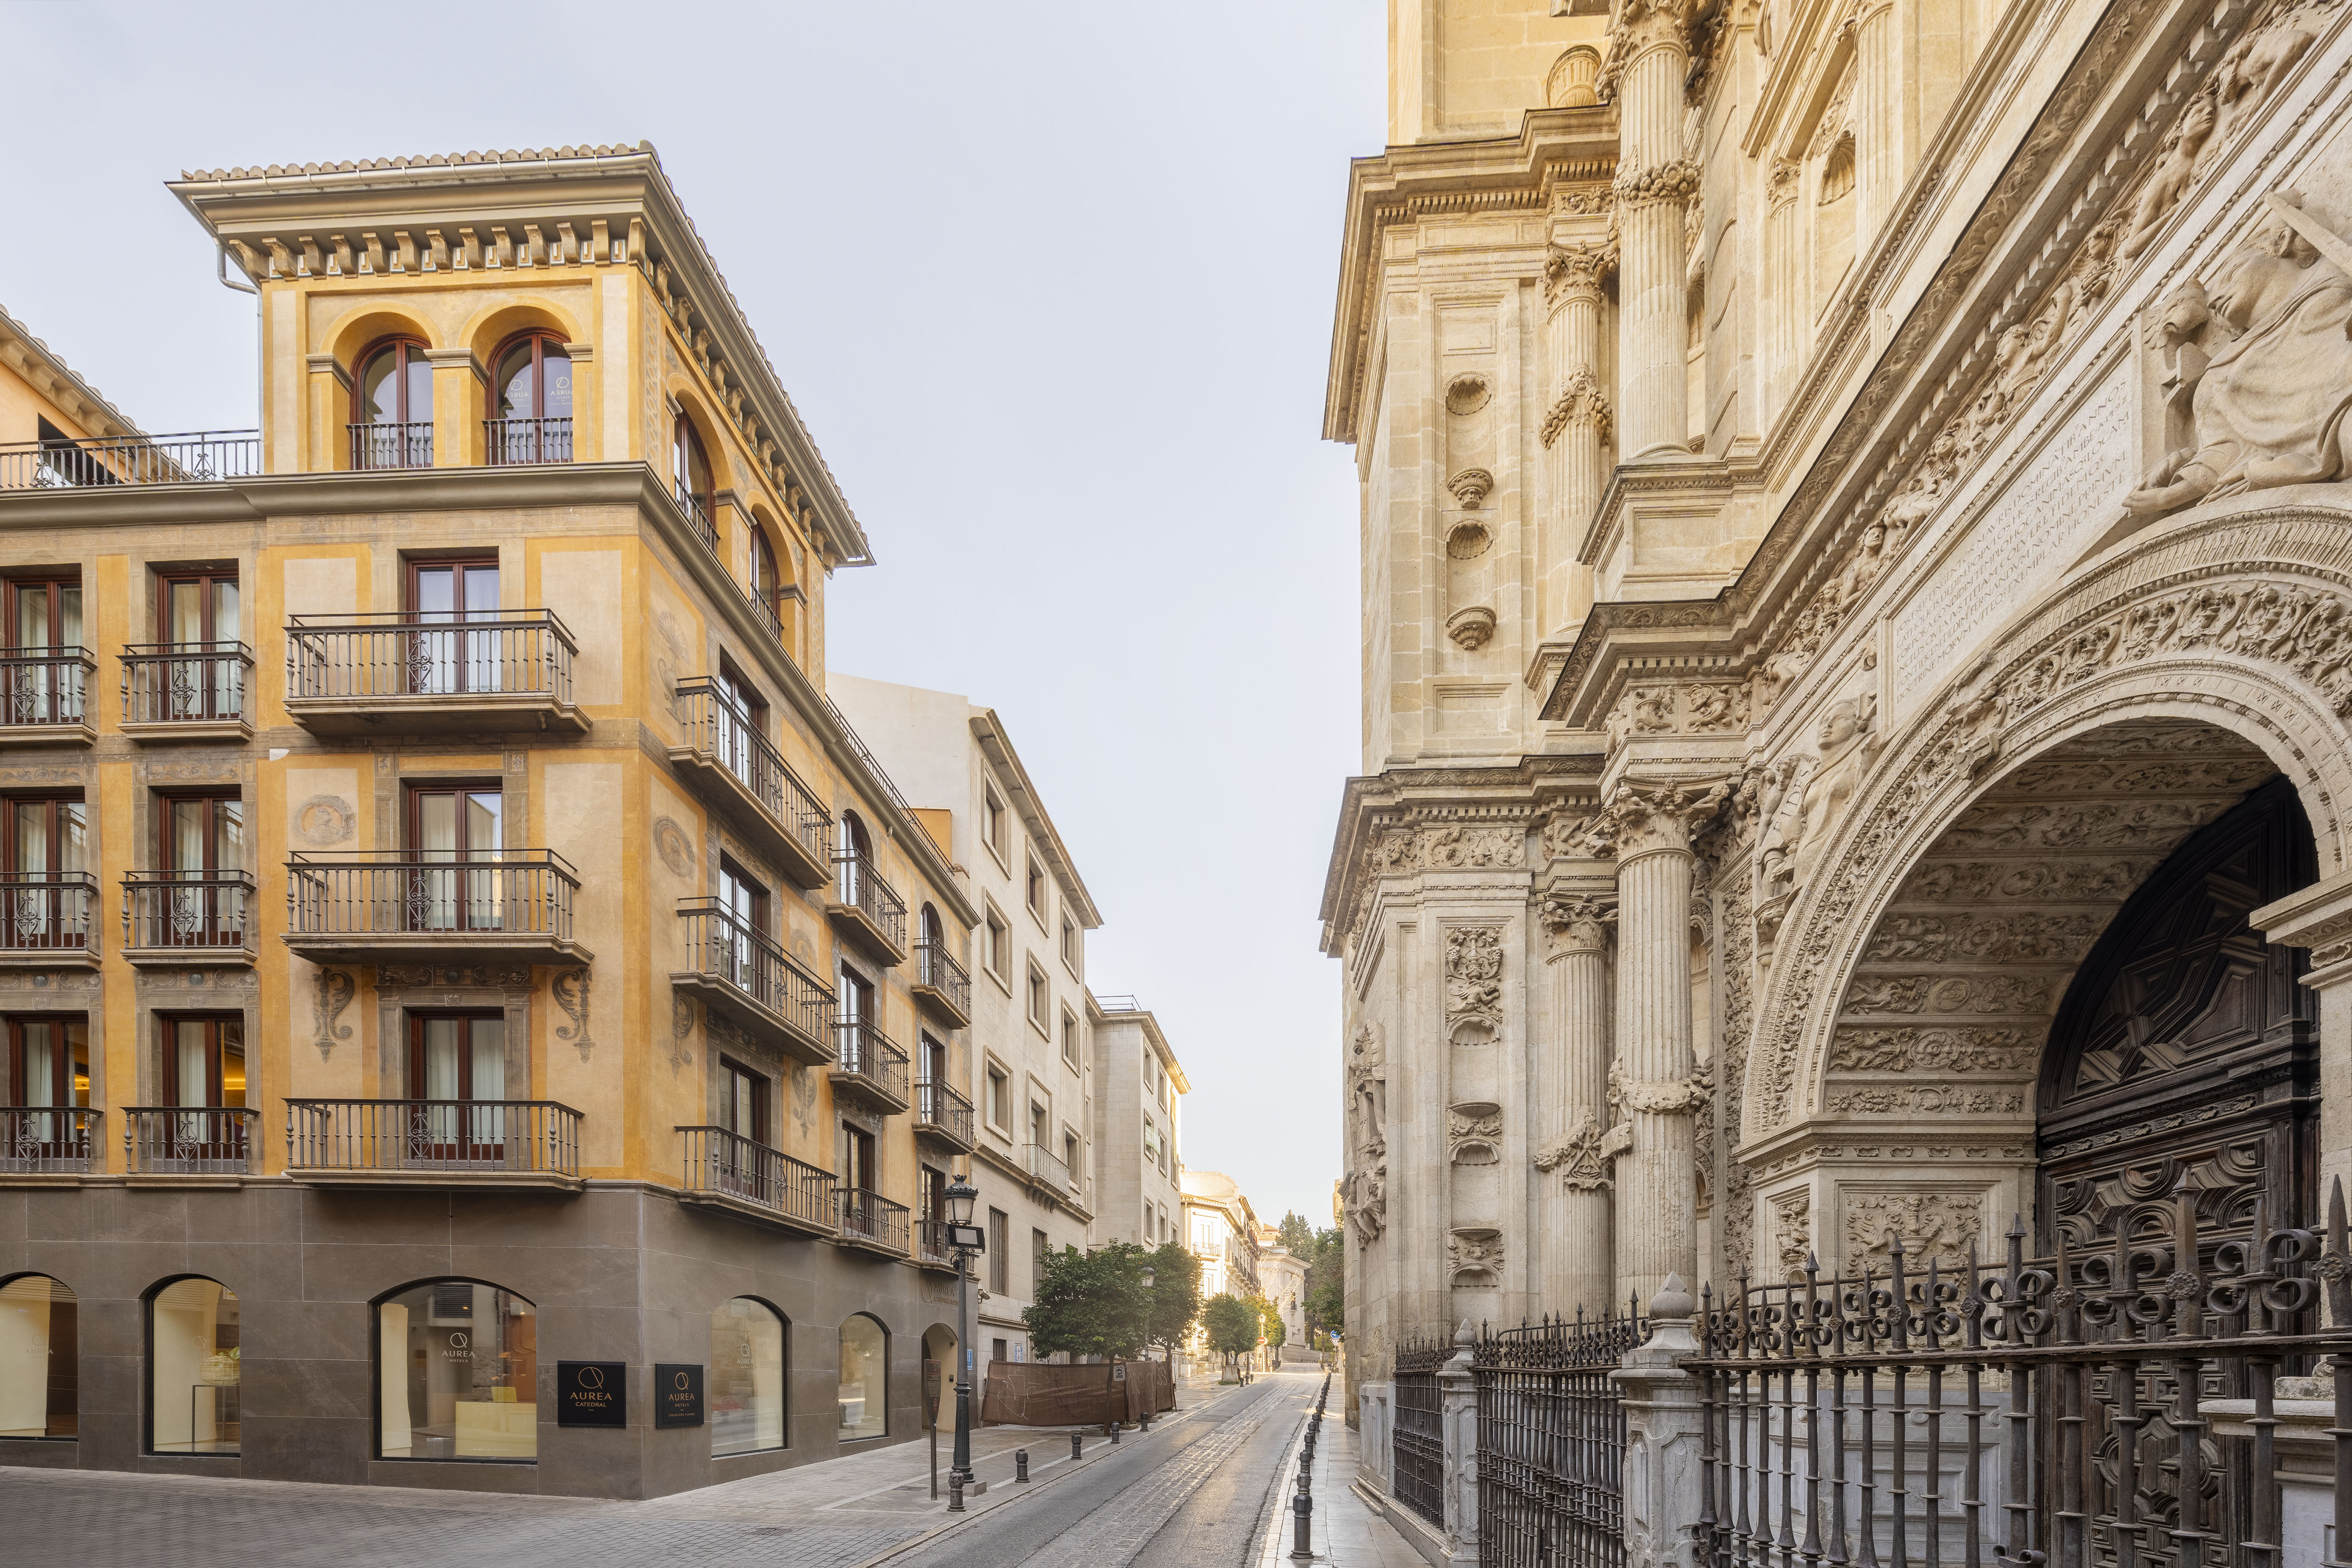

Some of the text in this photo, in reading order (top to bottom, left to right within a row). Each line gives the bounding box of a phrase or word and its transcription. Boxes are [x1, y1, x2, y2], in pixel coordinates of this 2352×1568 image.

[1970, 548, 2029, 616] FERNANDVM
[2078, 449, 2125, 507] PRIMVM
[2000, 511, 2048, 570] COLVERE
[1897, 659, 1935, 705] DOCTRINE
[1938, 623, 1971, 664] MORVM
[2008, 529, 2063, 595] EXEMPLAR
[2068, 467, 2125, 535] HONESTE
[1897, 618, 1932, 664] CORPORA
[934, 1283, 954, 1296] AUREA
[570, 1392, 612, 1401] AUREA
